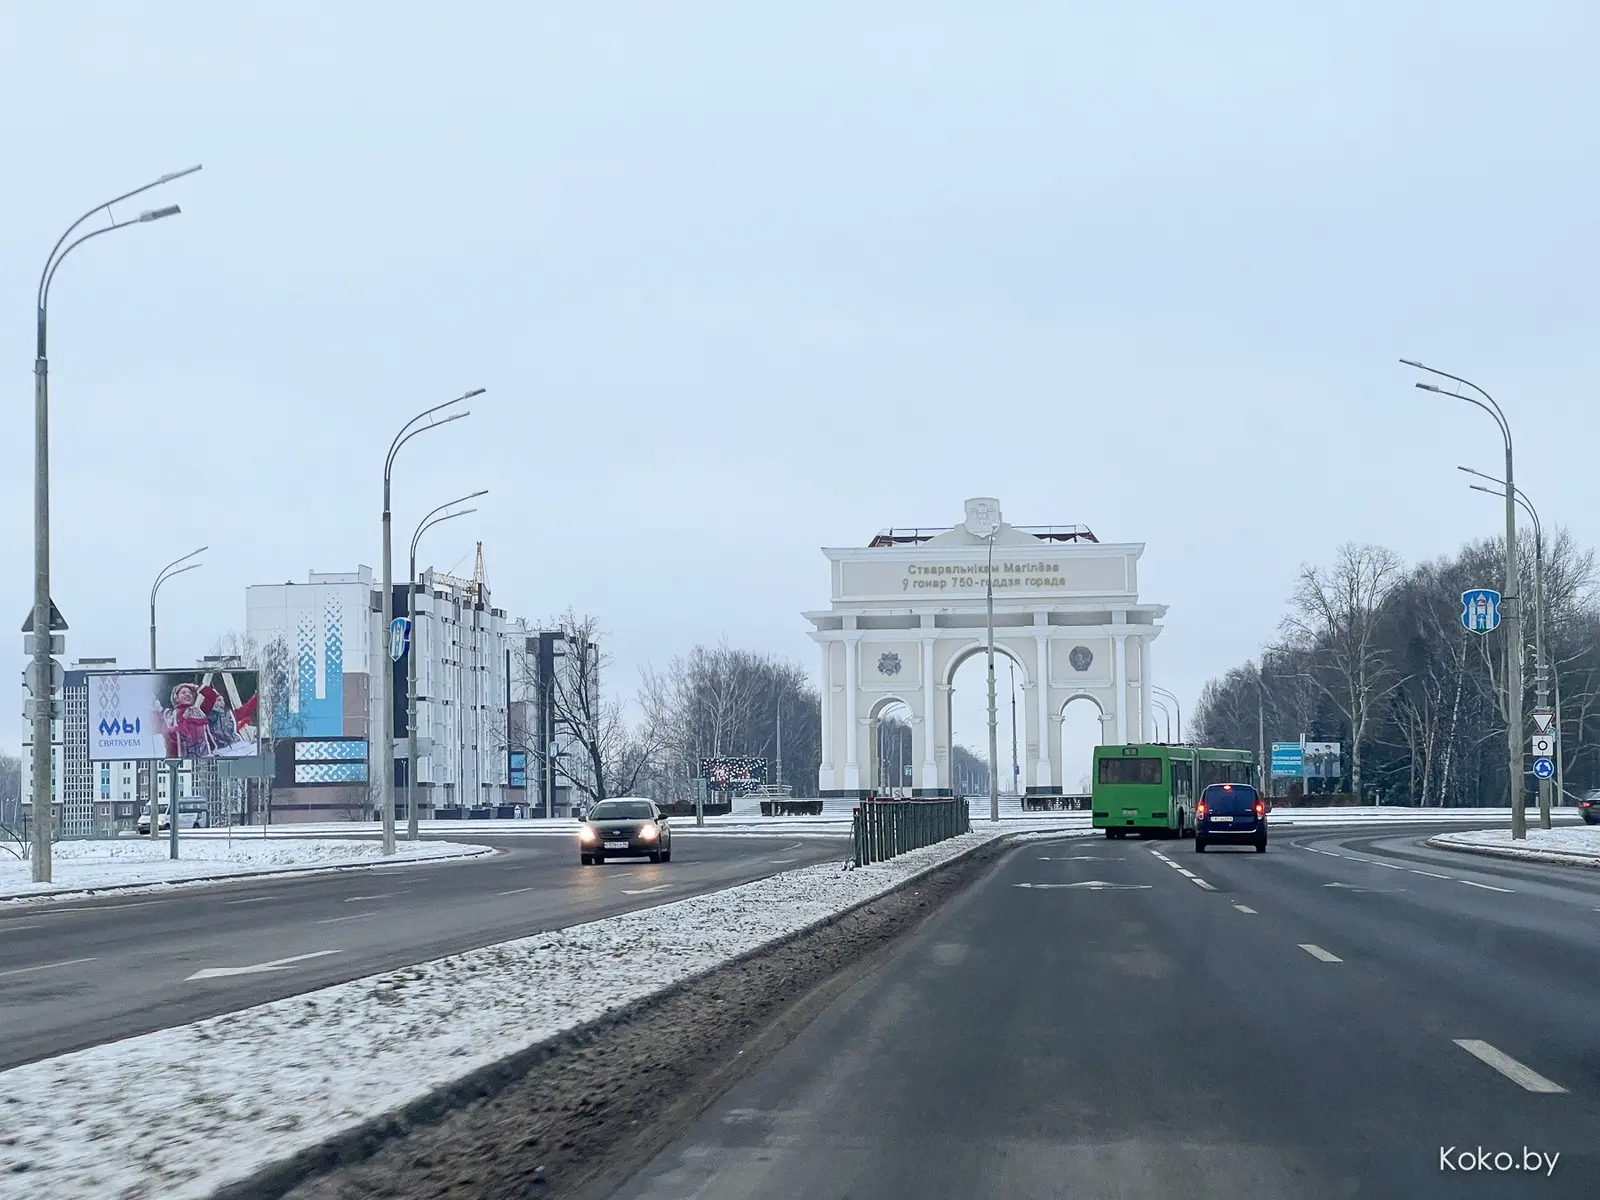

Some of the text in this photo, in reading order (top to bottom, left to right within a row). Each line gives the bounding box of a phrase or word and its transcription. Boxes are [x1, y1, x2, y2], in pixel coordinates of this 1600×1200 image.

[908, 561, 1059, 576] Стваральнікам Магілёва
[913, 580, 947, 590] гонар
[1025, 577, 1066, 588] горада
[99, 739, 141, 748] СВЯТКУЕМ
